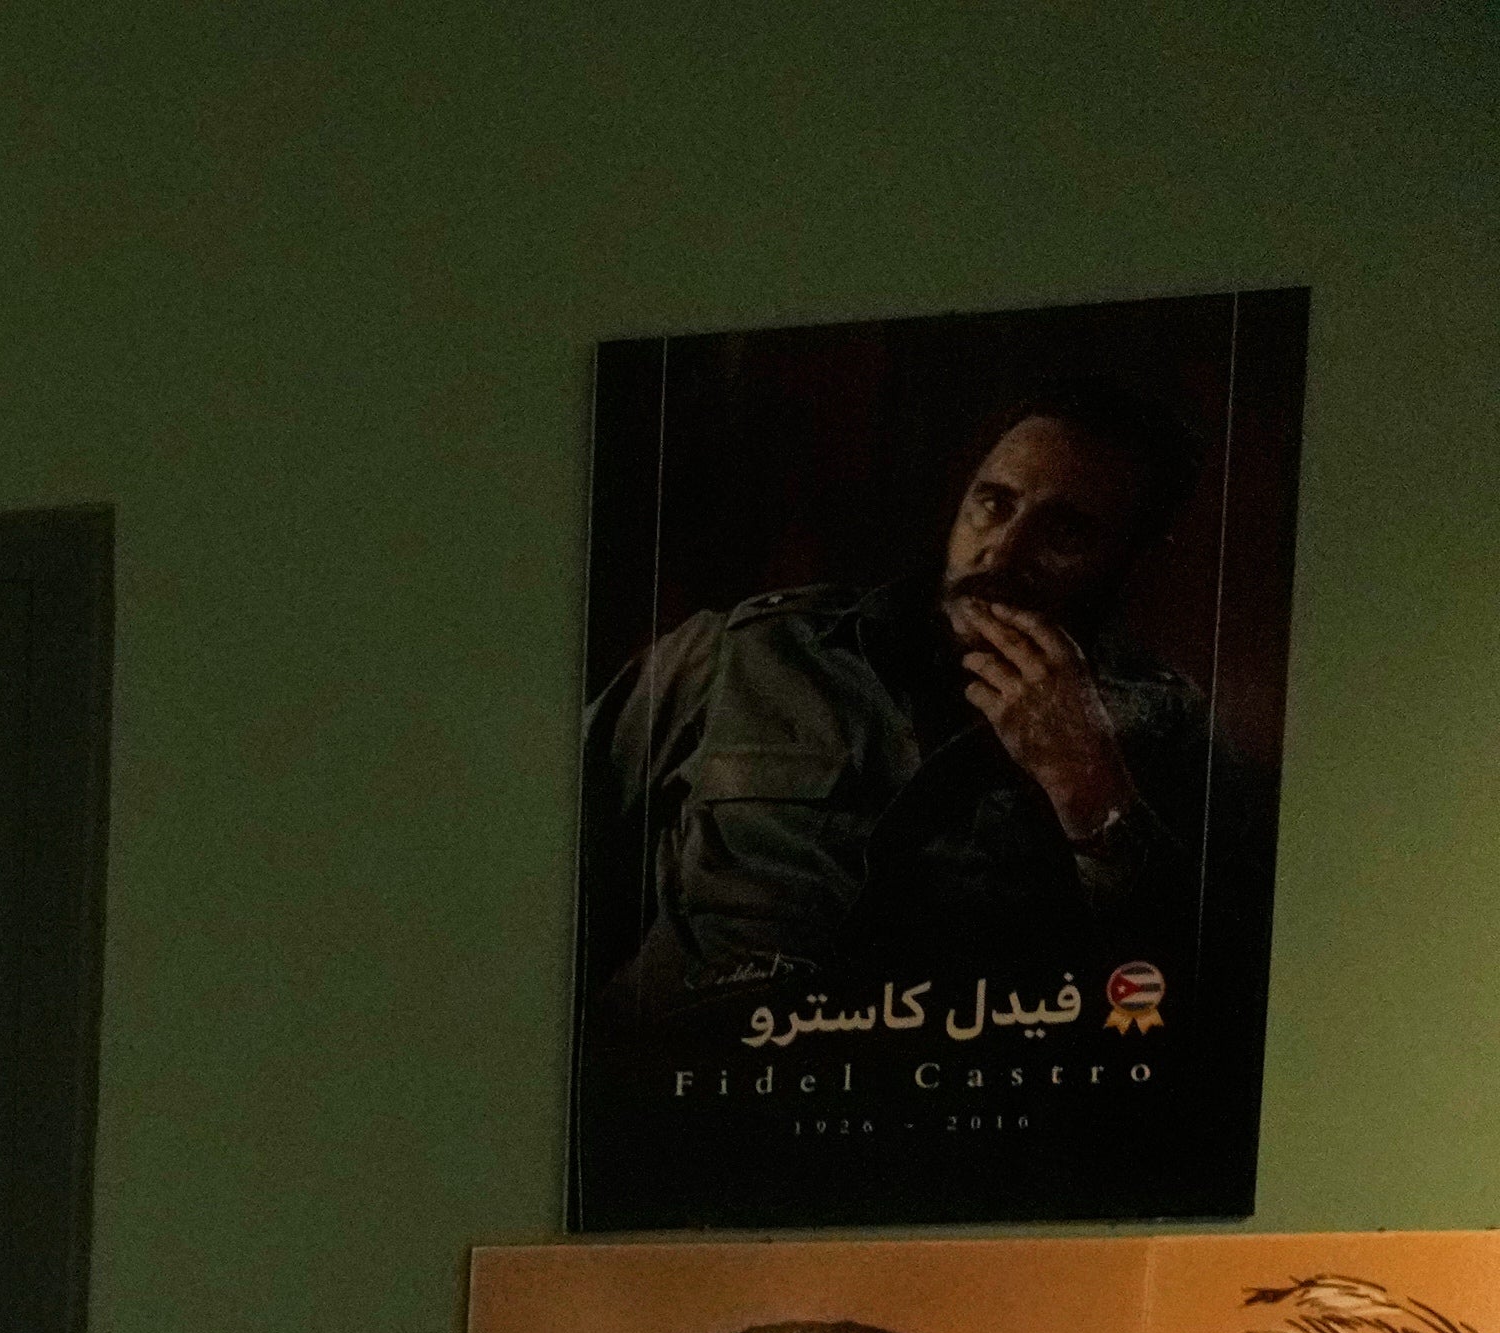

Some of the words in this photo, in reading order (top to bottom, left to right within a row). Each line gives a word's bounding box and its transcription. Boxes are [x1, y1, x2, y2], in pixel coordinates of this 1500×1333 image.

[740, 980, 932, 1048] کاسترو
[944, 971, 1083, 1041] فیدل
[674, 1062, 852, 1096] Fidel
[914, 1061, 1153, 1090] Castro
